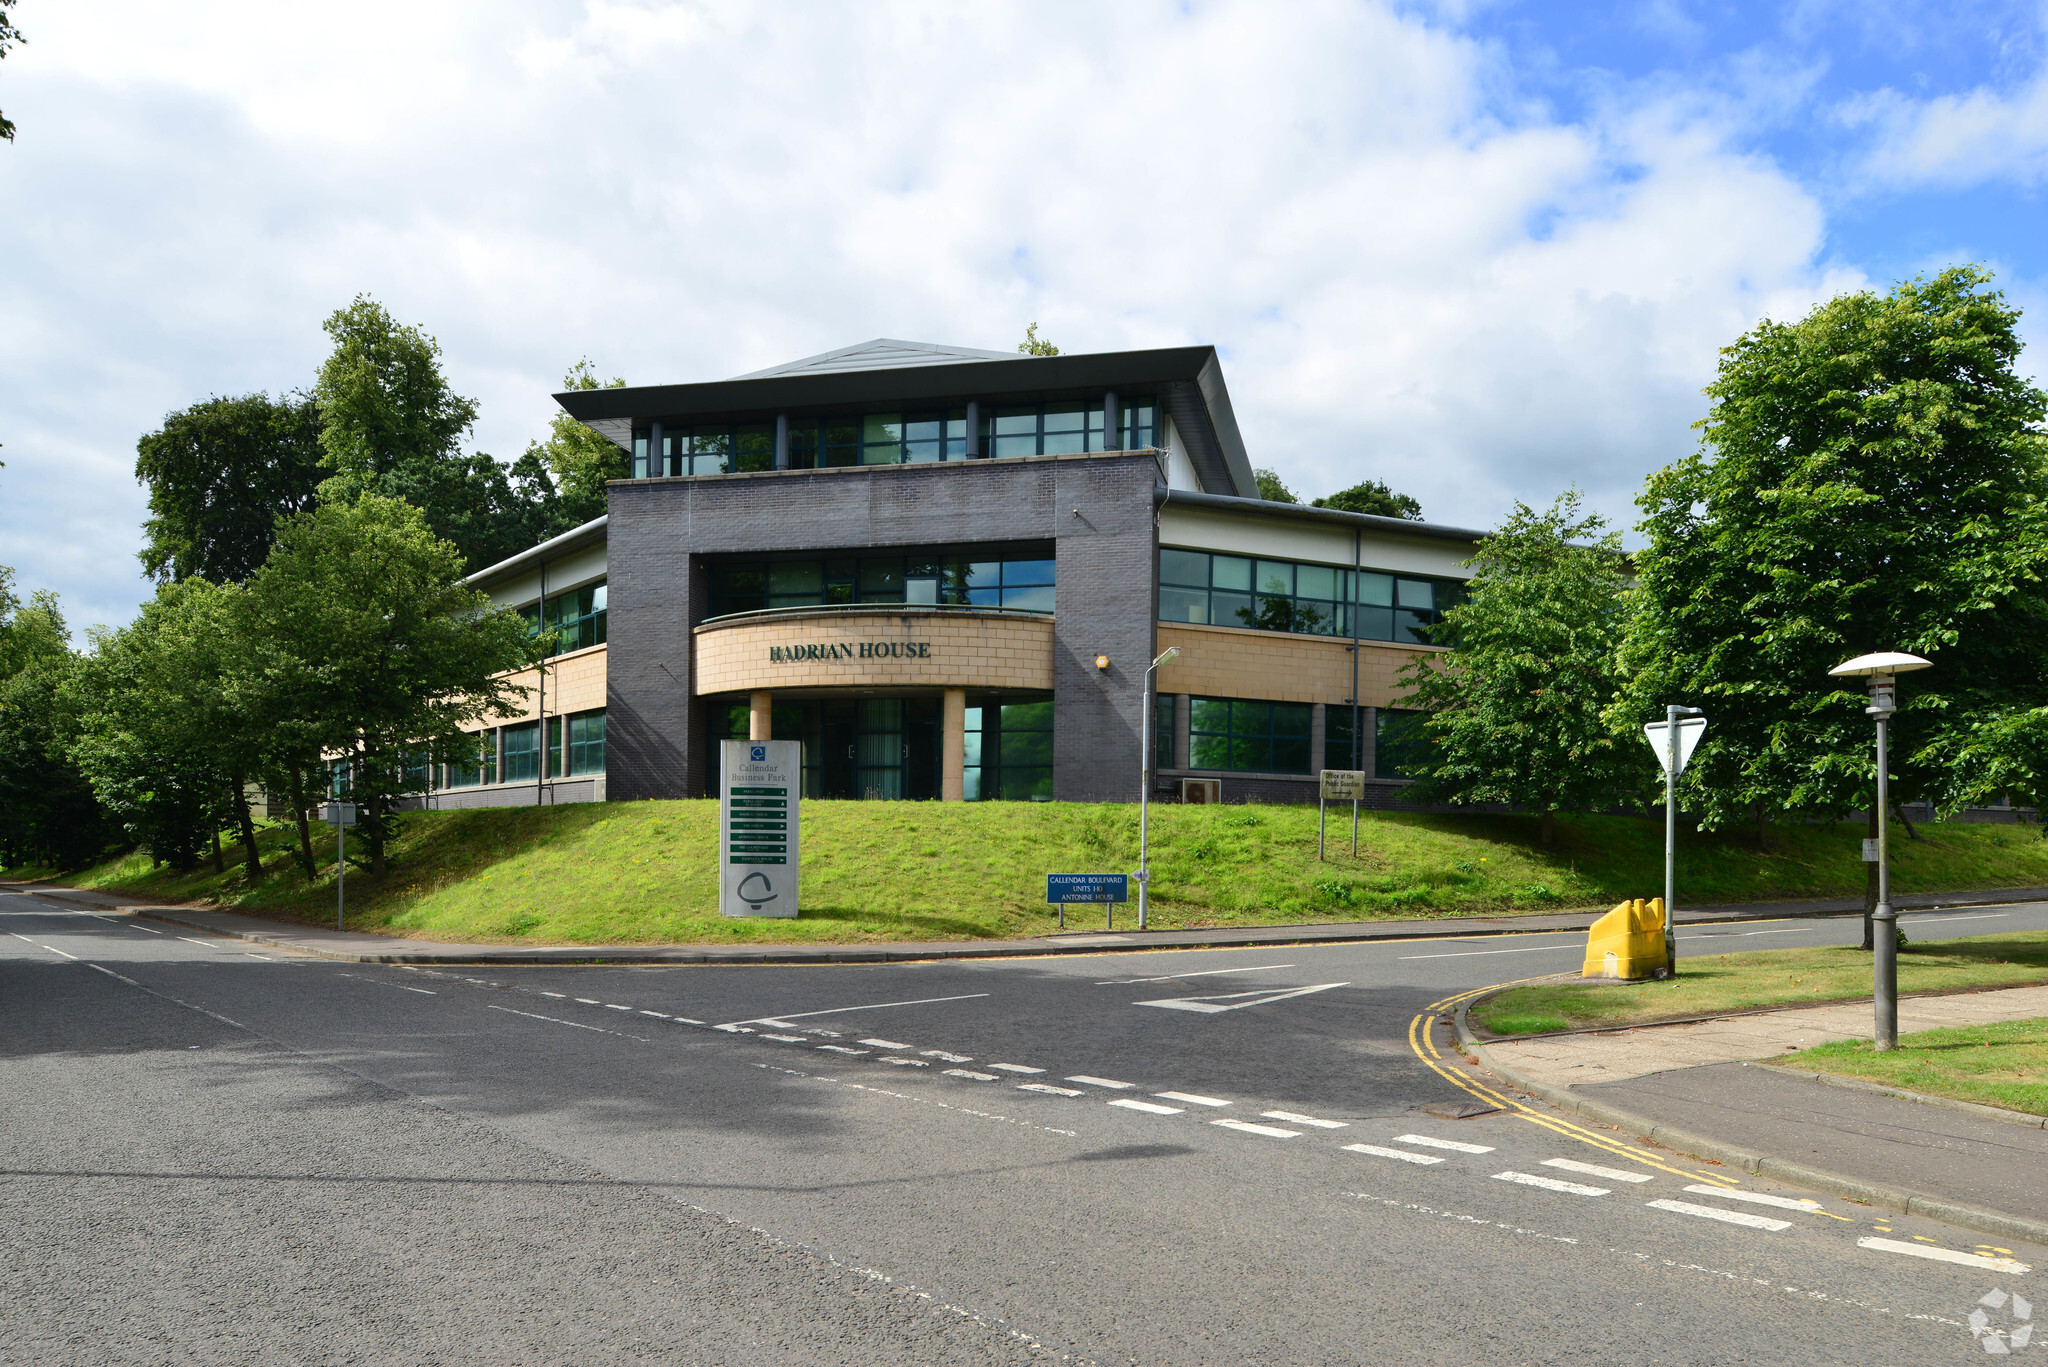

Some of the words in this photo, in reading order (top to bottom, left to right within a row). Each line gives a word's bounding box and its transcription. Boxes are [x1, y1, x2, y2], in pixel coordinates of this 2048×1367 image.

[769, 642, 853, 661] HADRIAN
[859, 642, 932, 659] HOUSE
[739, 764, 778, 772] Callendar
[732, 773, 765, 782] Business
[767, 773, 786, 782] Park
